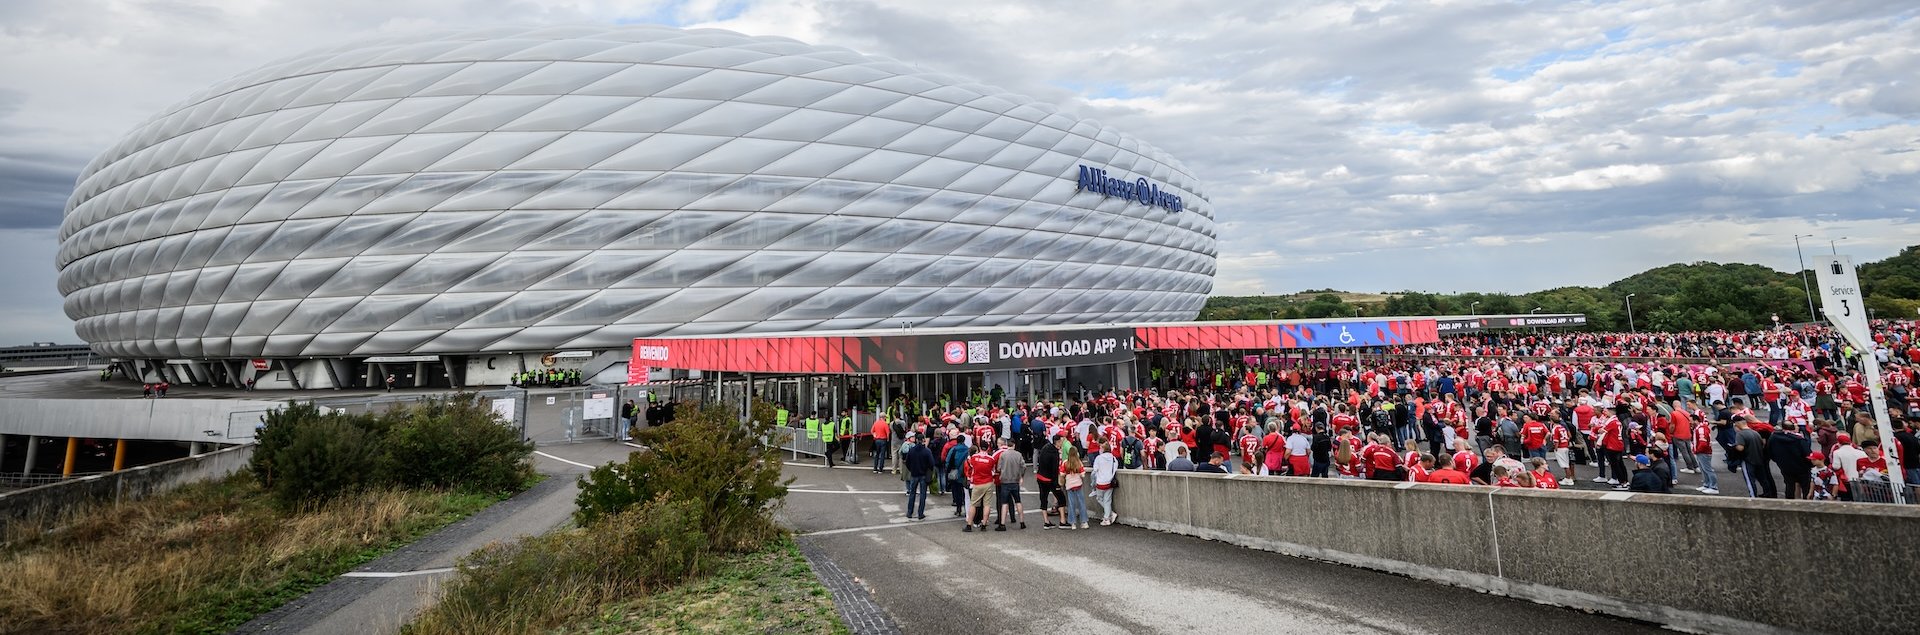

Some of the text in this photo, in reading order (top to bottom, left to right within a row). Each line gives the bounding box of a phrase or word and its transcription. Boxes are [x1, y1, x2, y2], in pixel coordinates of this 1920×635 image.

[1078, 165, 1183, 212] Allianz Arena
[1831, 286, 1854, 296] Service
[1841, 299, 1850, 317] 3
[999, 340, 1091, 359] DOWNLOAD
[1094, 338, 1117, 354] APP
[487, 356, 497, 370] C
[1536, 407, 1547, 416] 17
[981, 431, 992, 442] 42
[1246, 442, 1258, 452] 27
[1465, 458, 1472, 472] 9
